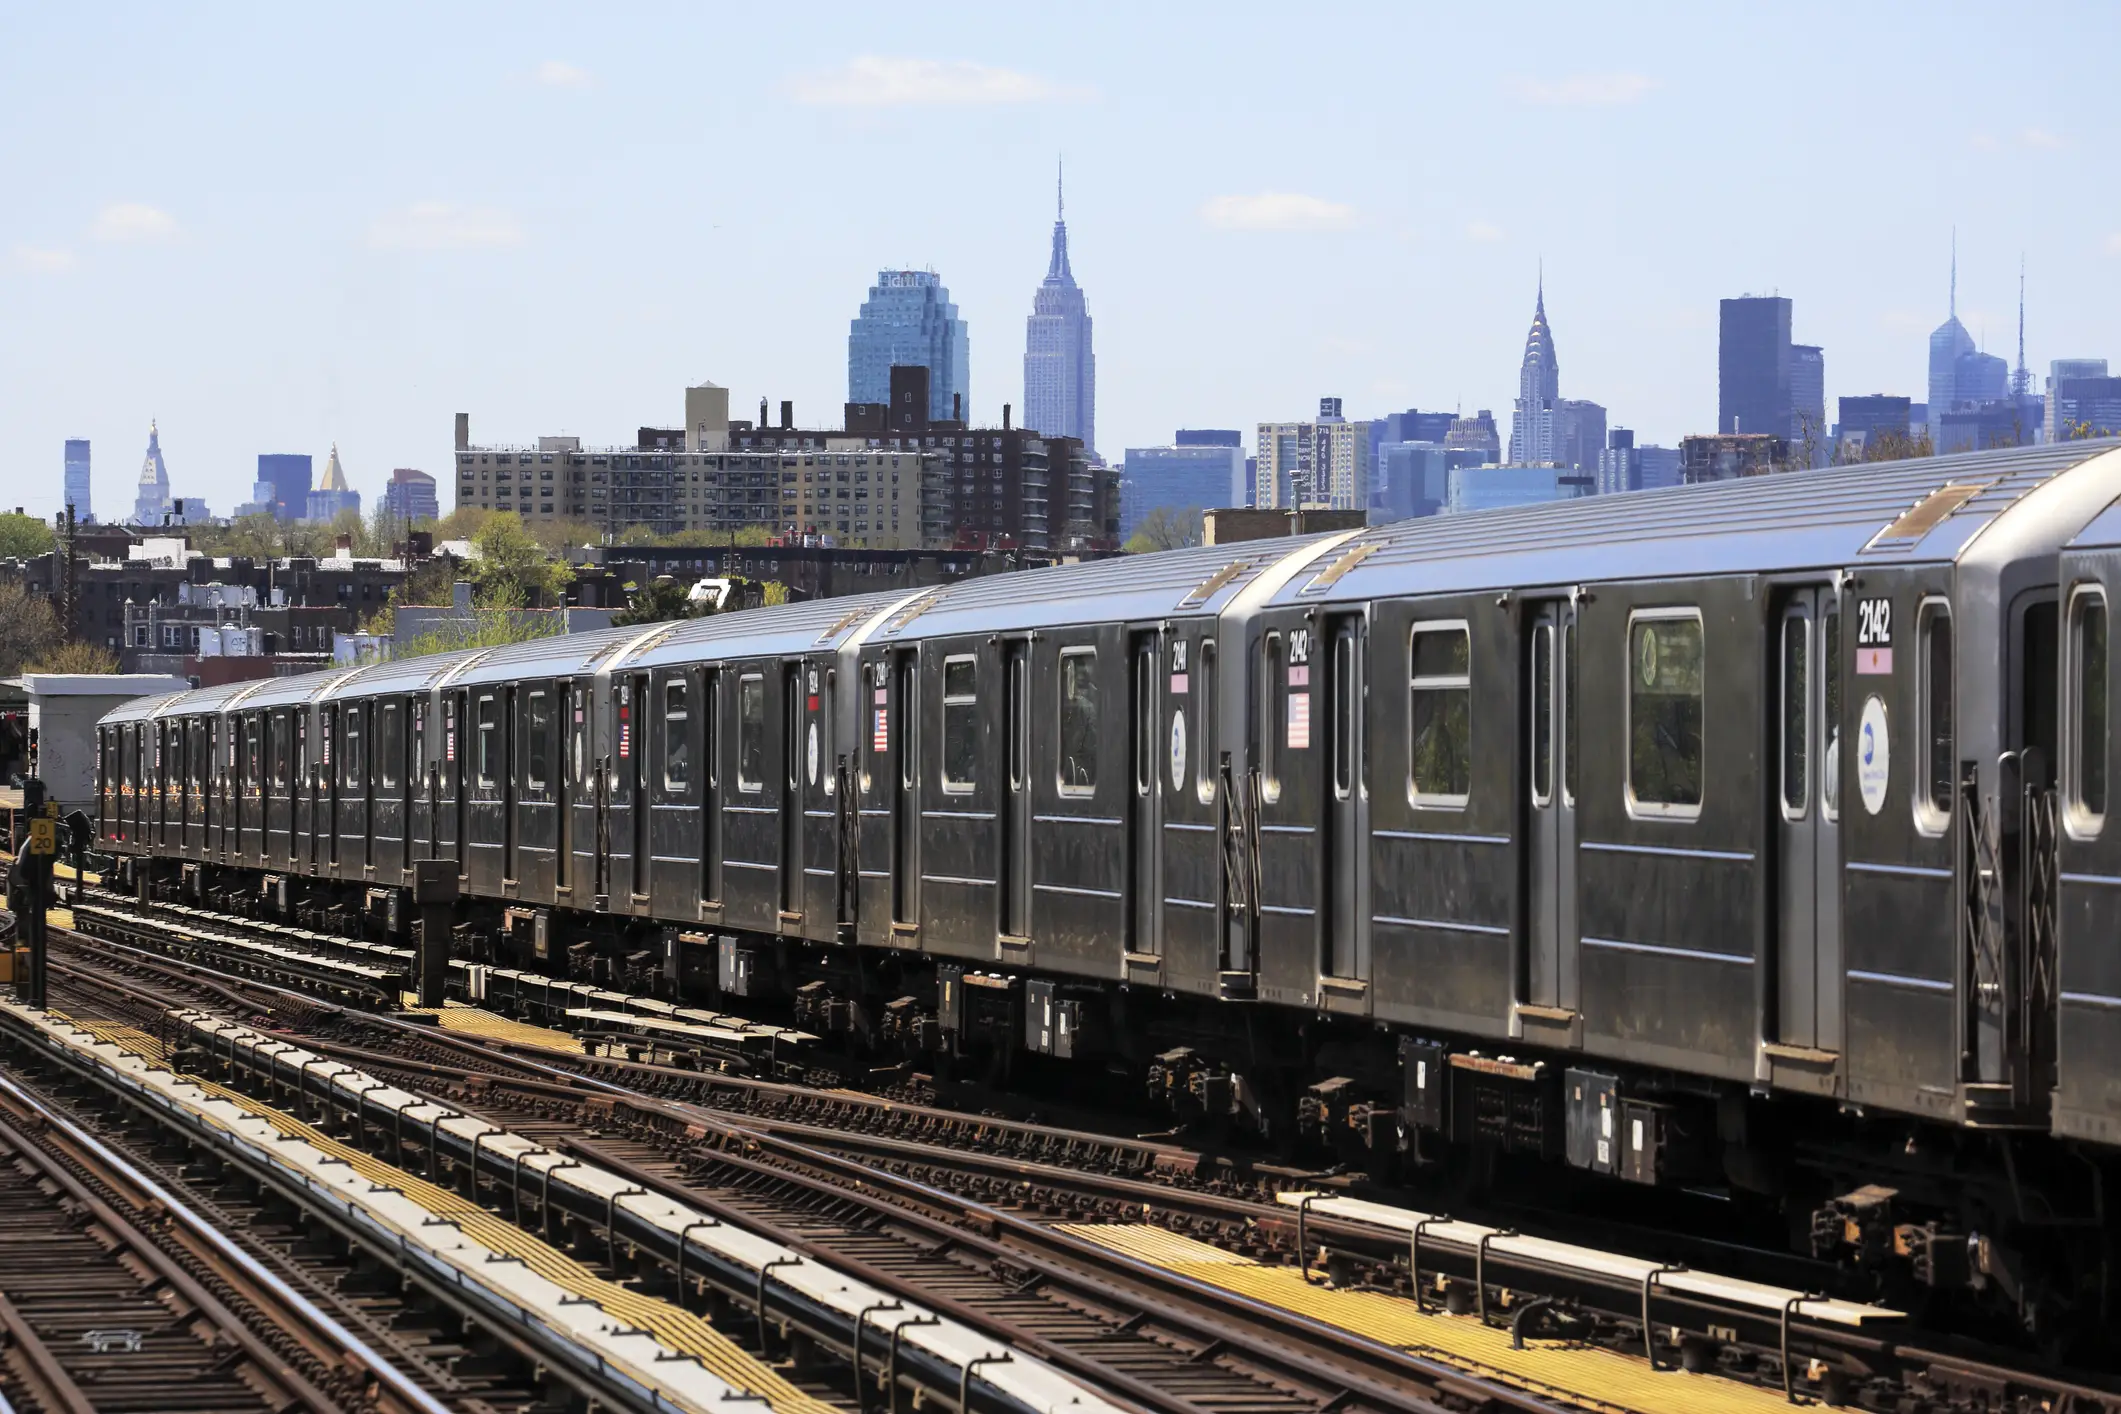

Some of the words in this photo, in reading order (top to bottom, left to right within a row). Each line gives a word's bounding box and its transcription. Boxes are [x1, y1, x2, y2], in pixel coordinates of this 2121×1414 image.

[1859, 599, 1890, 643] 2142
[1172, 640, 1187, 671] 2141
[1290, 630, 1307, 662] 2142
[35, 838, 51, 849] 20
[39, 825, 47, 835] D
